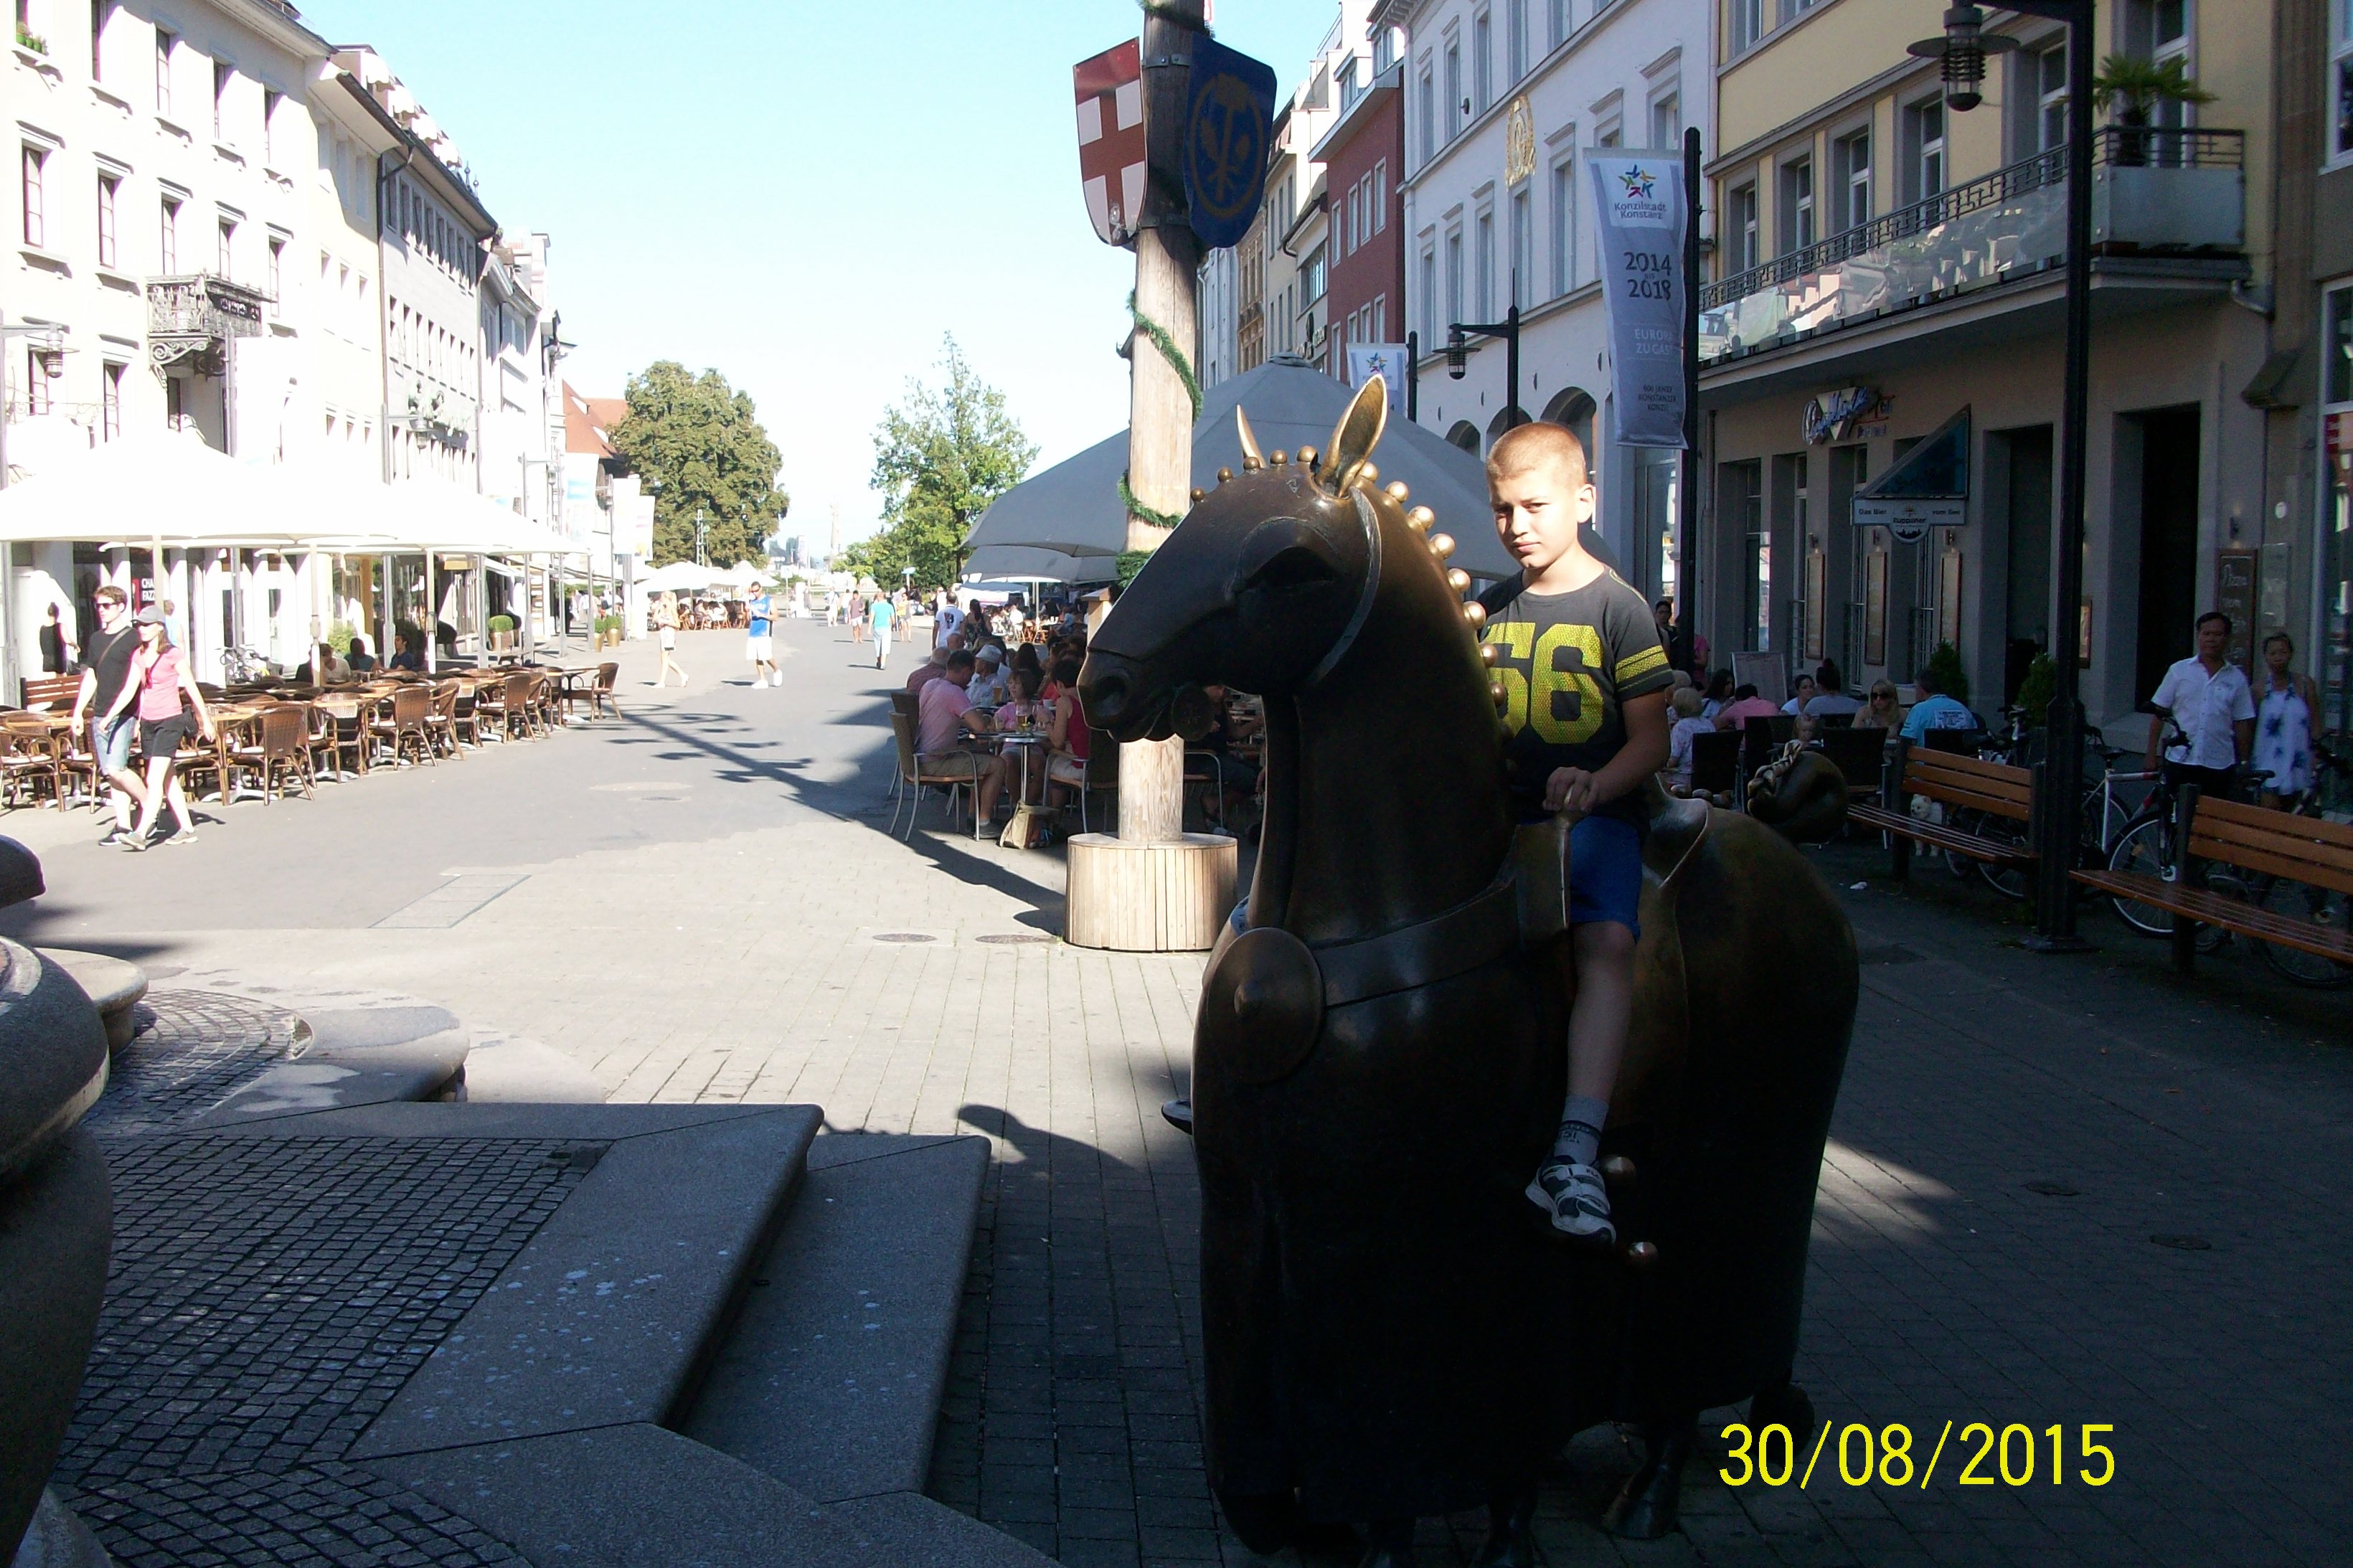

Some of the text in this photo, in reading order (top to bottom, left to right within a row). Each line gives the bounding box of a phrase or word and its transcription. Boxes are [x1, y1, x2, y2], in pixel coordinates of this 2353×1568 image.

[1614, 201, 1666, 212] Konzilstadt
[1621, 210, 1663, 219] Konstanz
[1624, 252, 1672, 276] 2014
[1627, 279, 1671, 301] 2018
[1636, 343, 1650, 354] ZU
